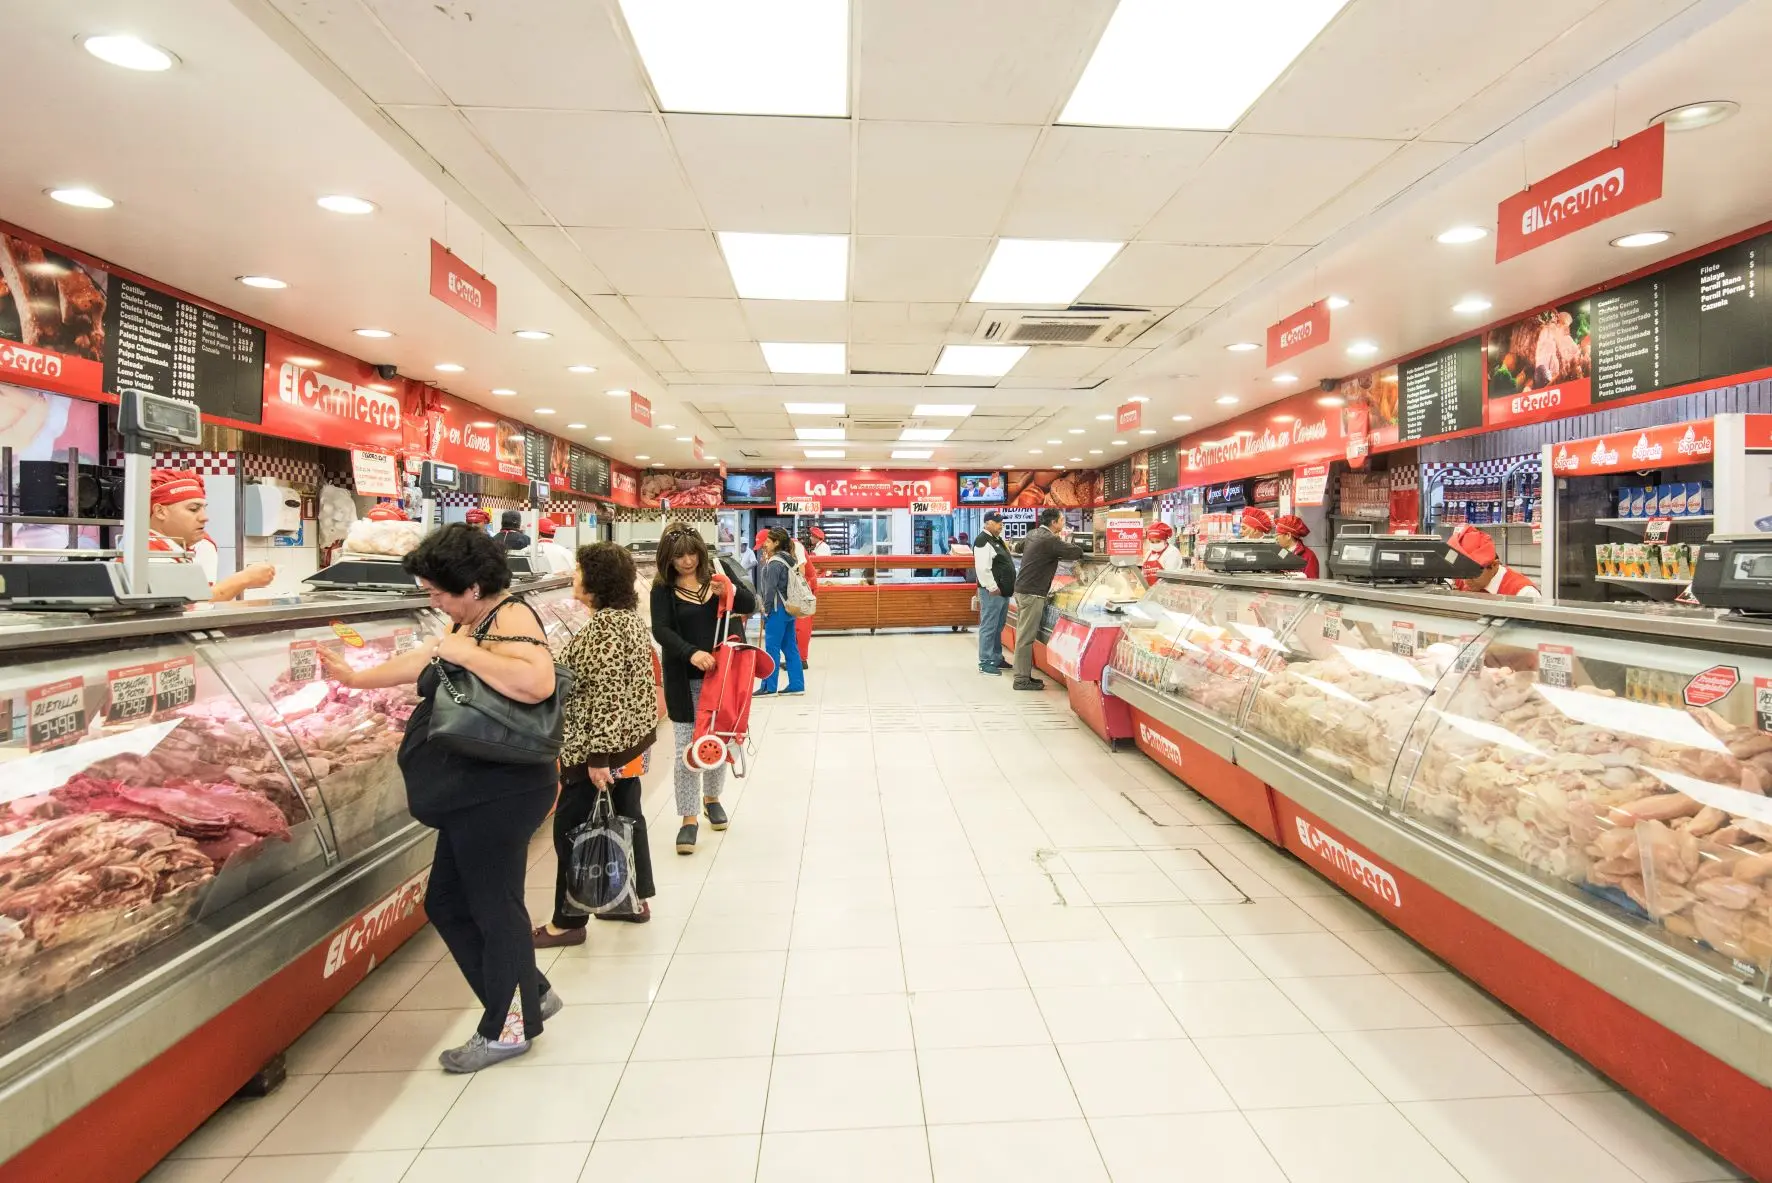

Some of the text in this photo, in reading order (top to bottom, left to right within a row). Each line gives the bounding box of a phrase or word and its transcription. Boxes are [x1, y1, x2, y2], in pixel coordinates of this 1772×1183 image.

[1537, 168, 1624, 228] Vacuno
[1701, 272, 1725, 284] Malaya
[279, 362, 401, 430] El Carnicero
[1521, 389, 1561, 411] Cerdo
[449, 427, 461, 444] en
[463, 423, 491, 453] Carnes
[1678, 437, 1711, 455] Soprole
[1194, 436, 1240, 467] Carnicero
[1632, 443, 1662, 461] Soprole
[805, 480, 826, 496] La
[120, 698, 147, 717] 7298
[167, 687, 189, 707] 1798
[41, 713, 76, 741] 3498
[1296, 816, 1401, 907] El Carnicero
[323, 927, 349, 979] El
